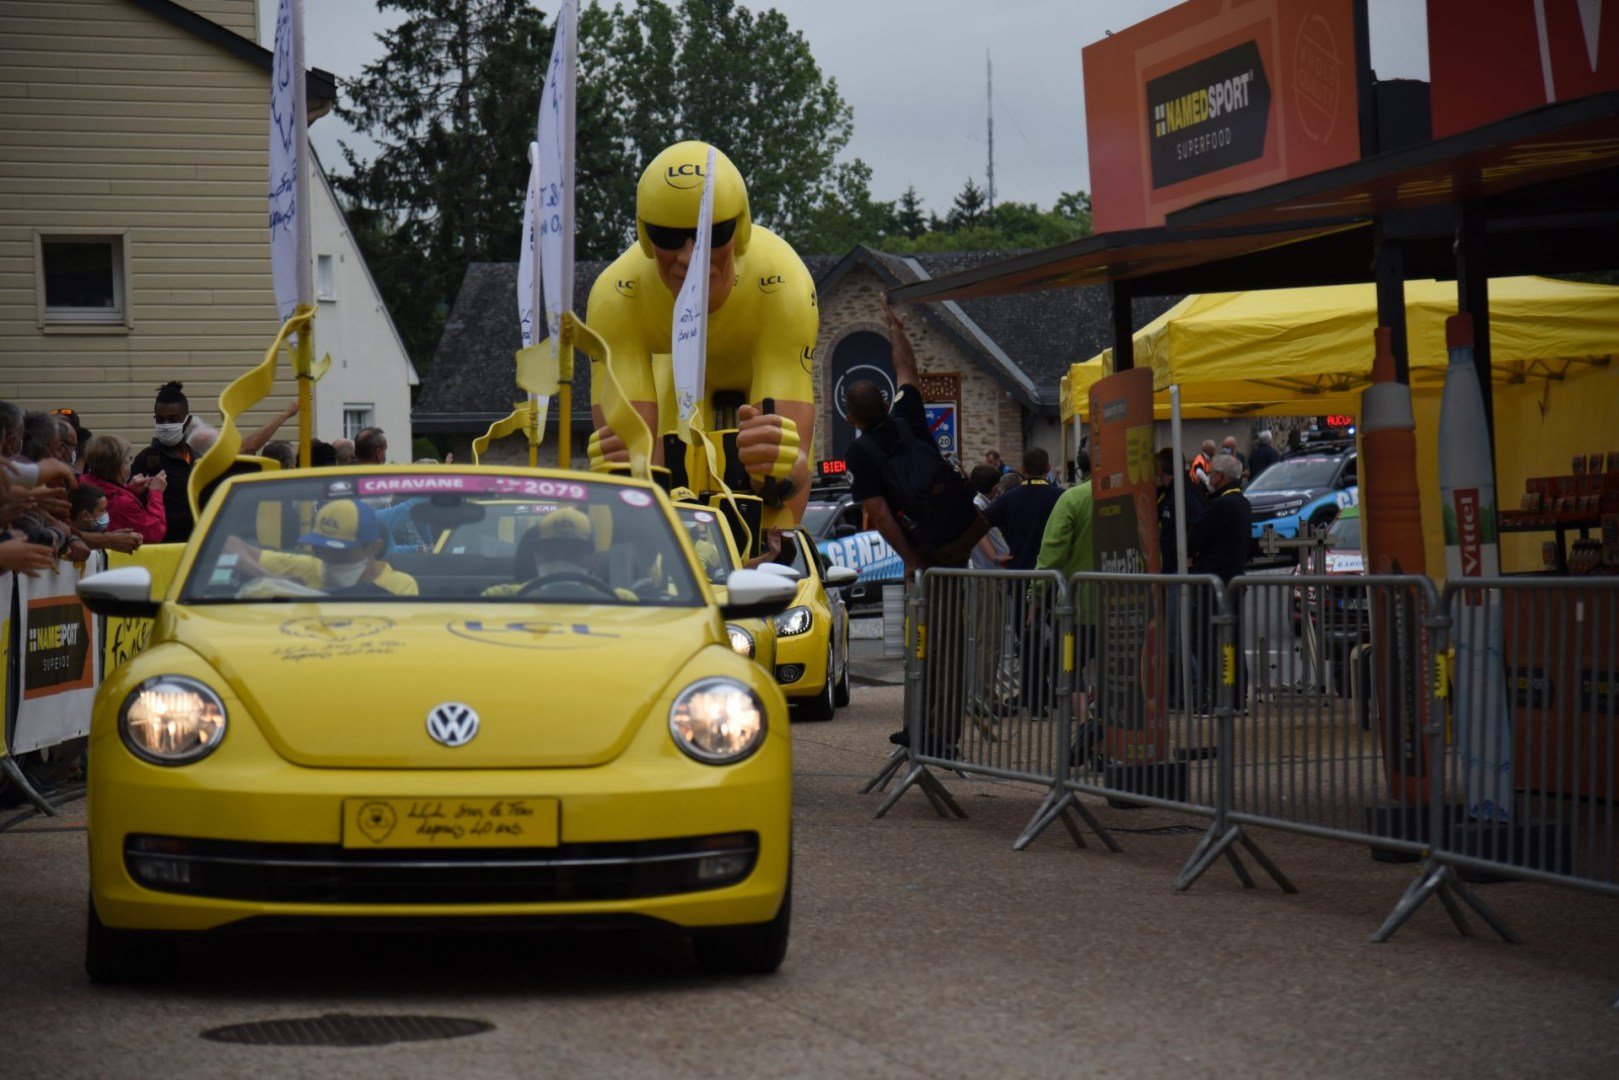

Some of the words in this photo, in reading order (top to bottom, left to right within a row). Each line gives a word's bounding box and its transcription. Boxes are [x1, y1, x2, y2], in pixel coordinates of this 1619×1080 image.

[1165, 72, 1250, 134] NAMEDSPORT
[1176, 126, 1232, 160] SUPERFOOD
[668, 164, 706, 178] LCL
[761, 275, 785, 287] LCL
[938, 437, 950, 446] 20
[822, 460, 847, 475] BIEN
[364, 477, 464, 492] CARAVANE
[523, 480, 585, 499] 2079
[1459, 496, 1478, 576] Vittel
[464, 620, 622, 639] LCL
[407, 801, 446, 818] LCL
[469, 821, 493, 836] 40
